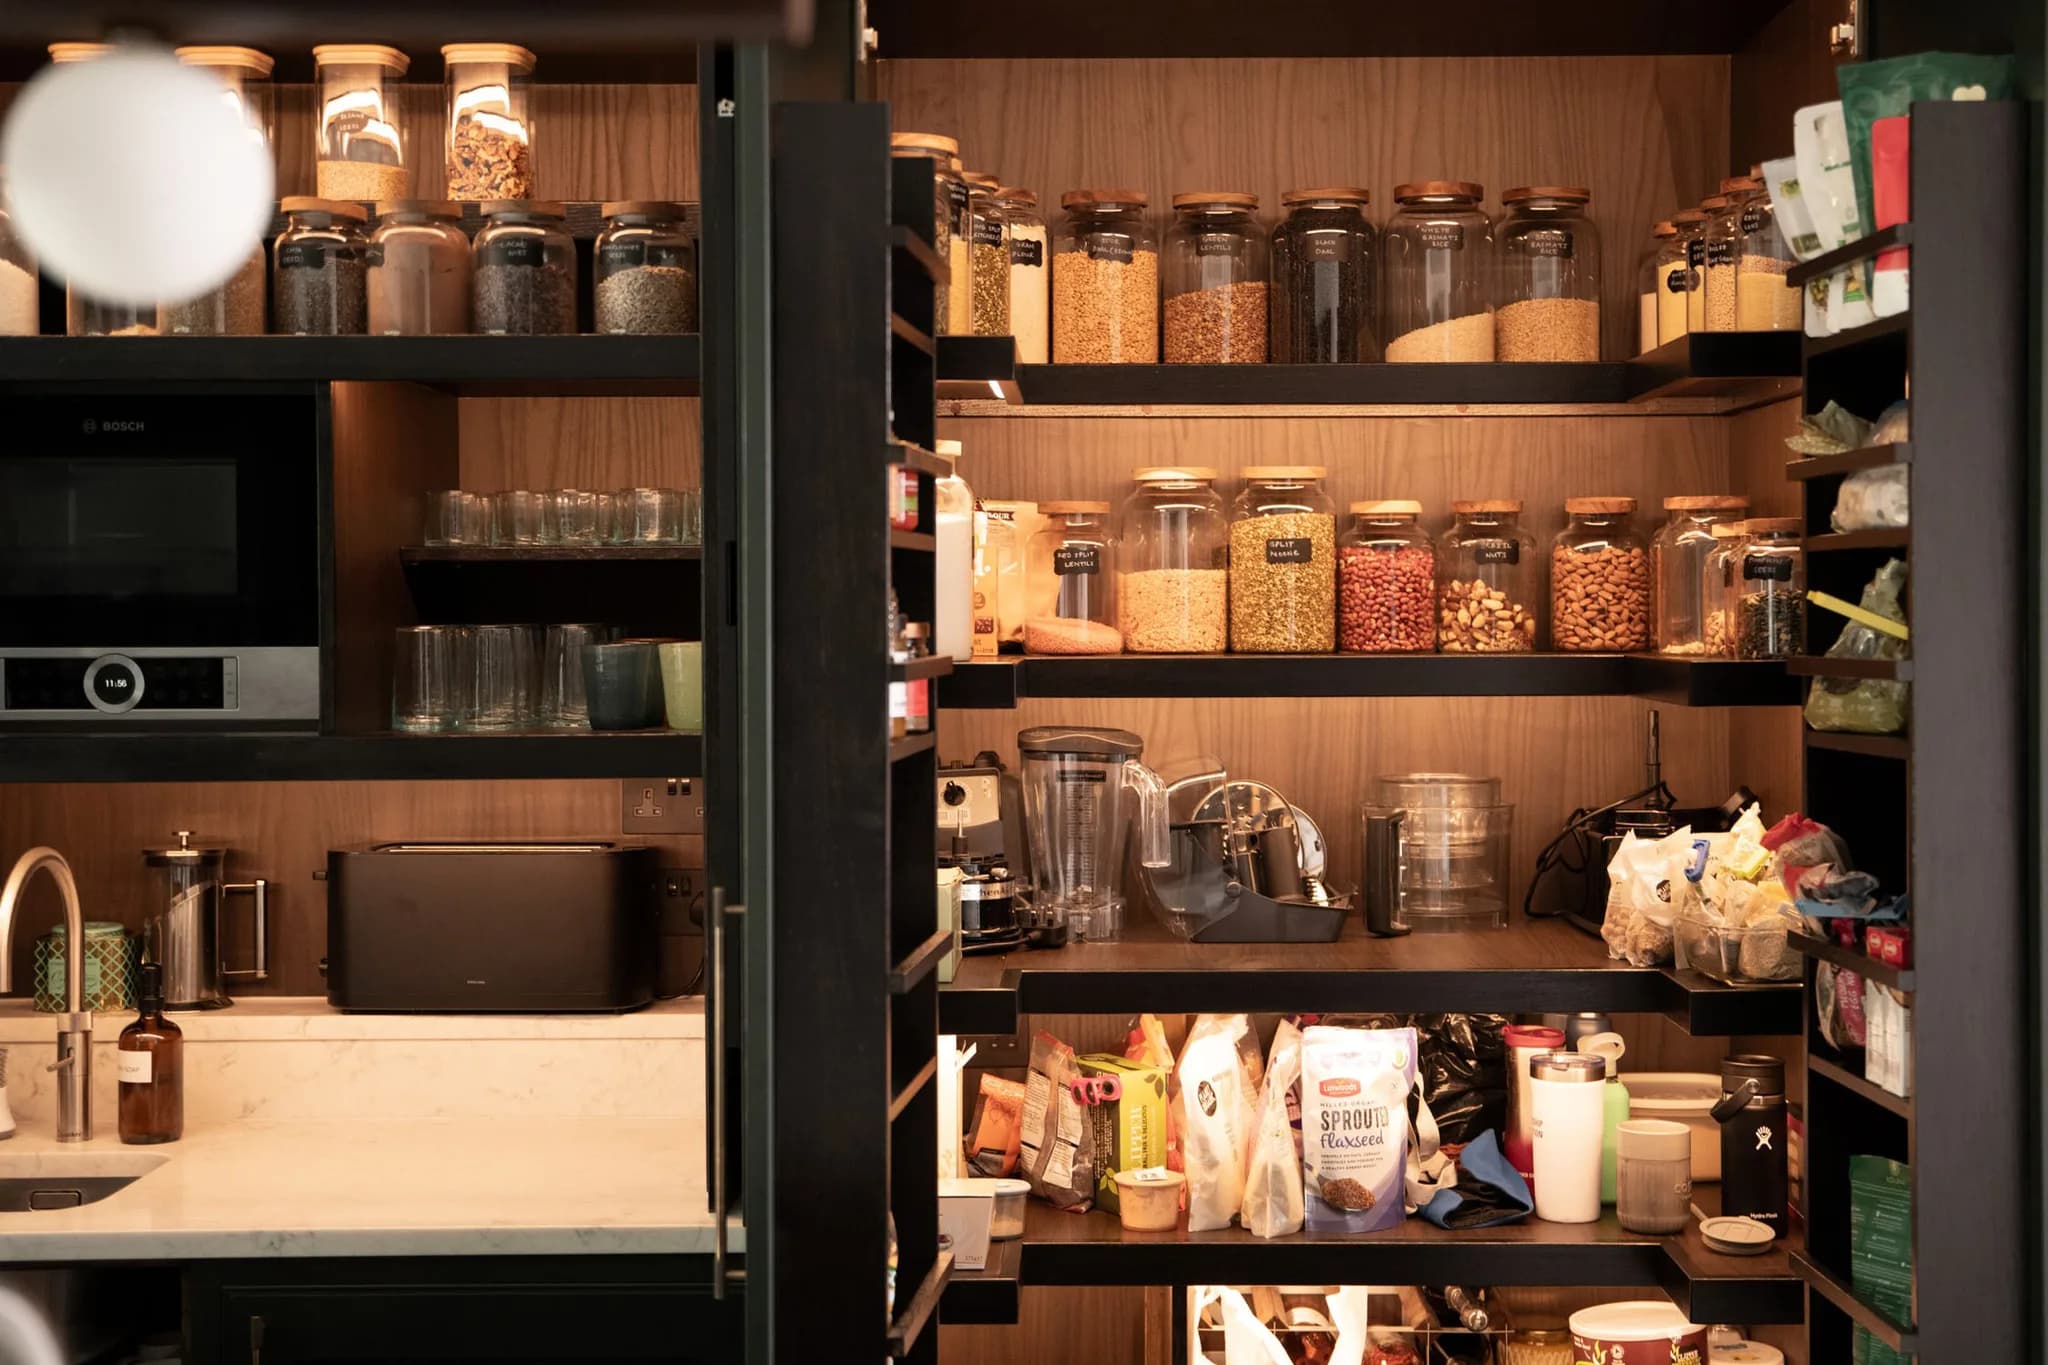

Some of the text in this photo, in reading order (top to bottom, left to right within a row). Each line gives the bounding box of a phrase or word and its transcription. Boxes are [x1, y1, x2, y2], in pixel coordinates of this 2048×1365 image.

[103, 421, 145, 432] BOSCH
[1269, 540, 1295, 548] SPLIT
[1064, 560, 1094, 568] LENTILS
[105, 679, 128, 688] 11:56
[1320, 1128, 1384, 1149] flaxseed
